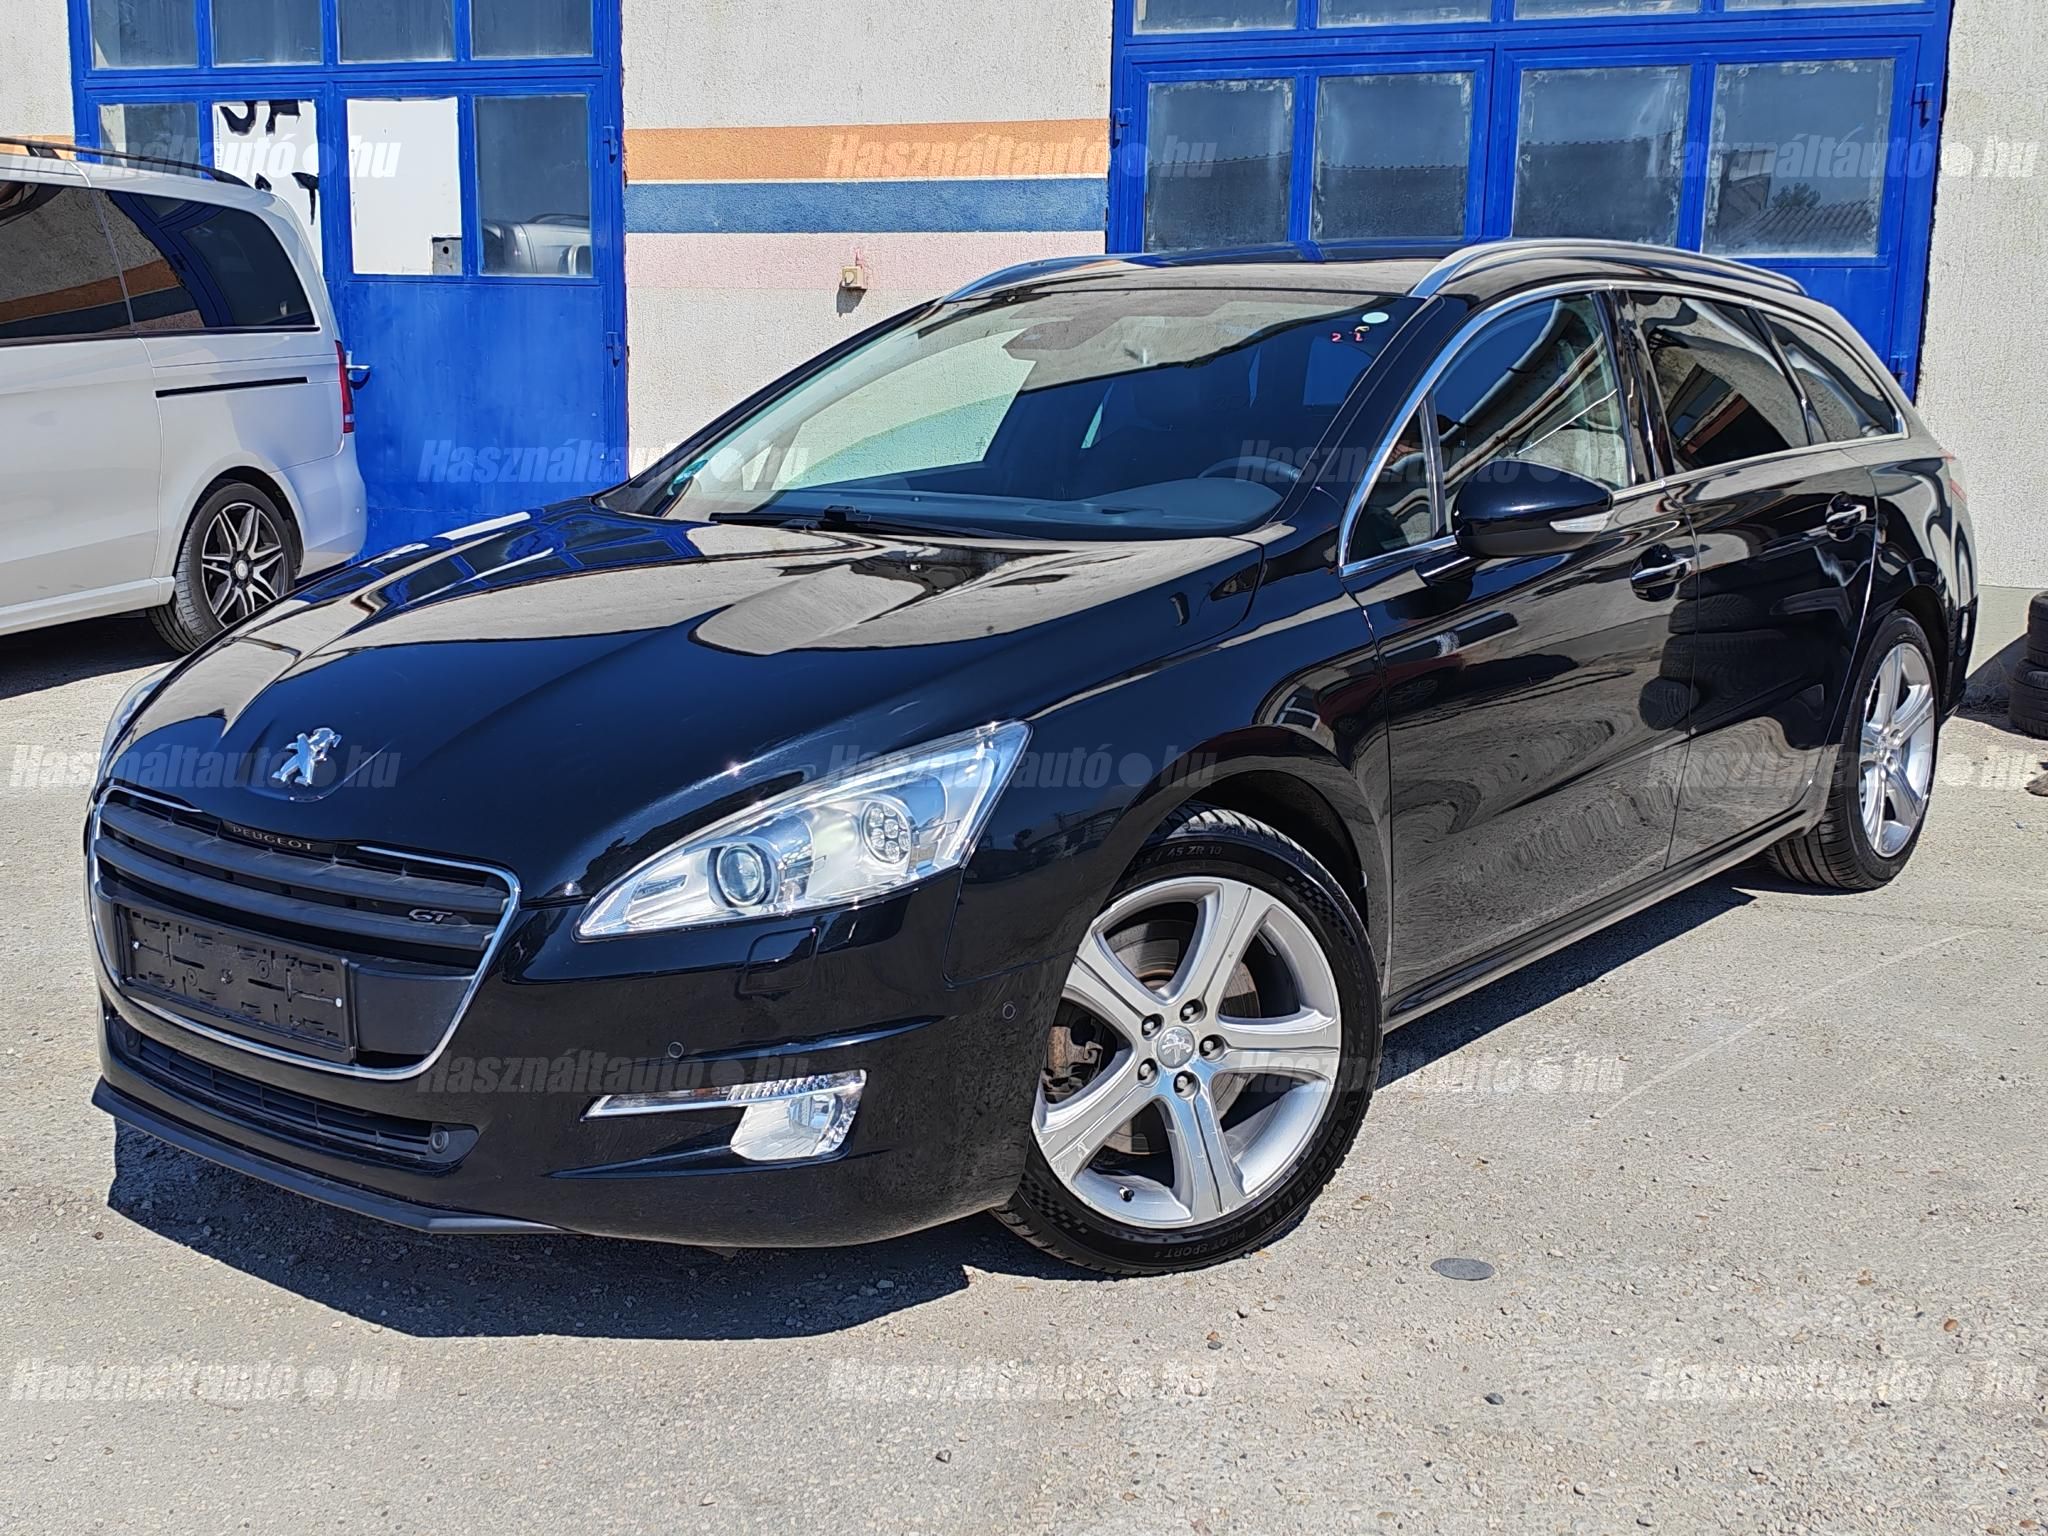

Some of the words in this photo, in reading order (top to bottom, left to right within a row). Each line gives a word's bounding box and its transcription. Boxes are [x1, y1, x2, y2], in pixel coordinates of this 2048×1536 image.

[231, 824, 313, 850] PEUGEOT
[408, 908, 453, 922] GT
[1258, 1124, 1346, 1229] MICHELIN
[1211, 1230, 1247, 1250] PILOT
[1164, 1243, 1209, 1258] SPORT
